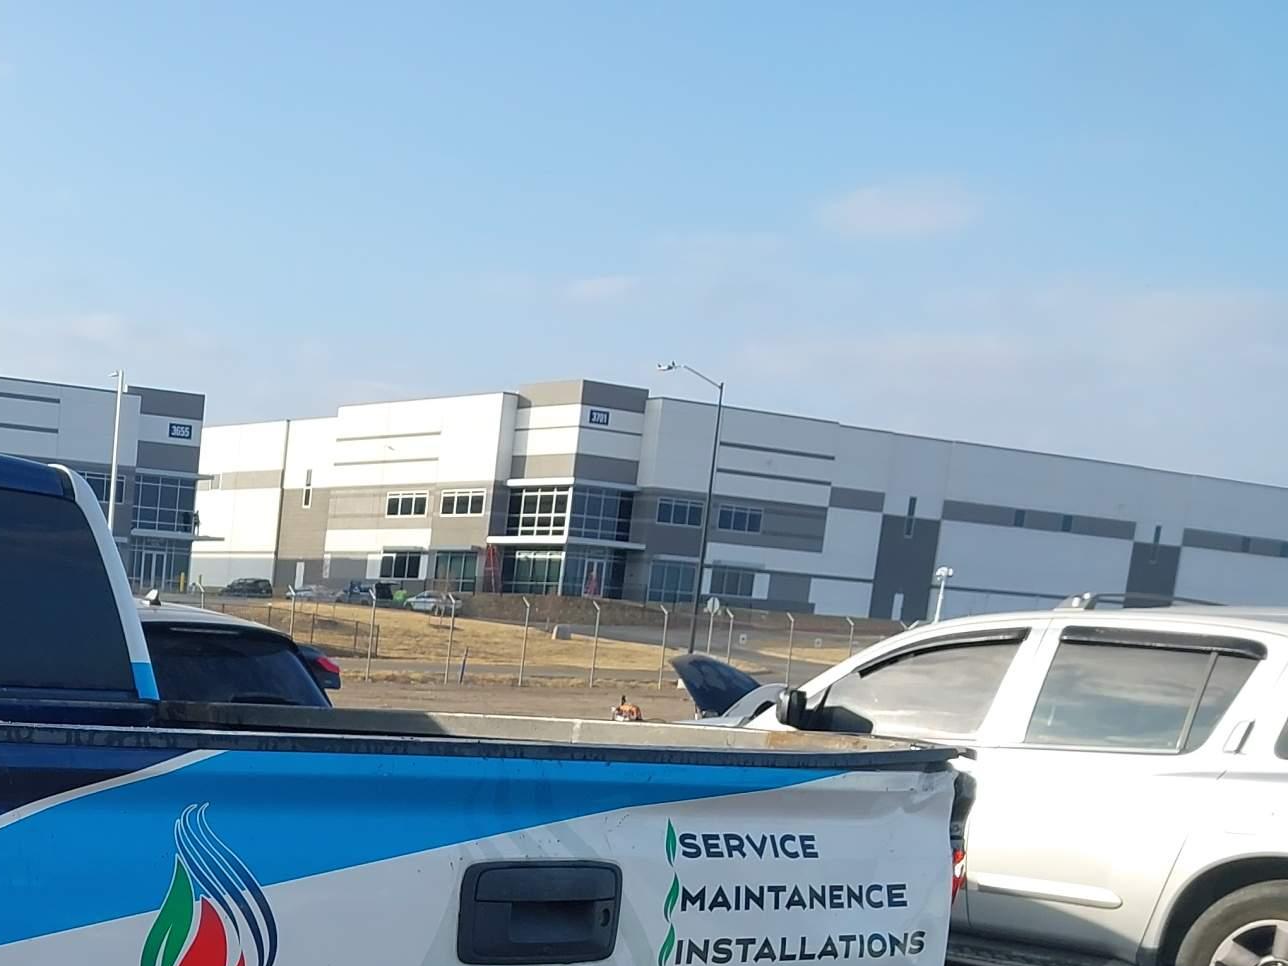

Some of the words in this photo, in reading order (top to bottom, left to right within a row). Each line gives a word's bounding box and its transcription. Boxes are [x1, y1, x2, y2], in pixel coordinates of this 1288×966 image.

[171, 425, 191, 438] 3655
[679, 833, 819, 859] SERVICE
[680, 883, 908, 912] MAINTANENCE
[674, 930, 925, 966] INSTALLATIONS
